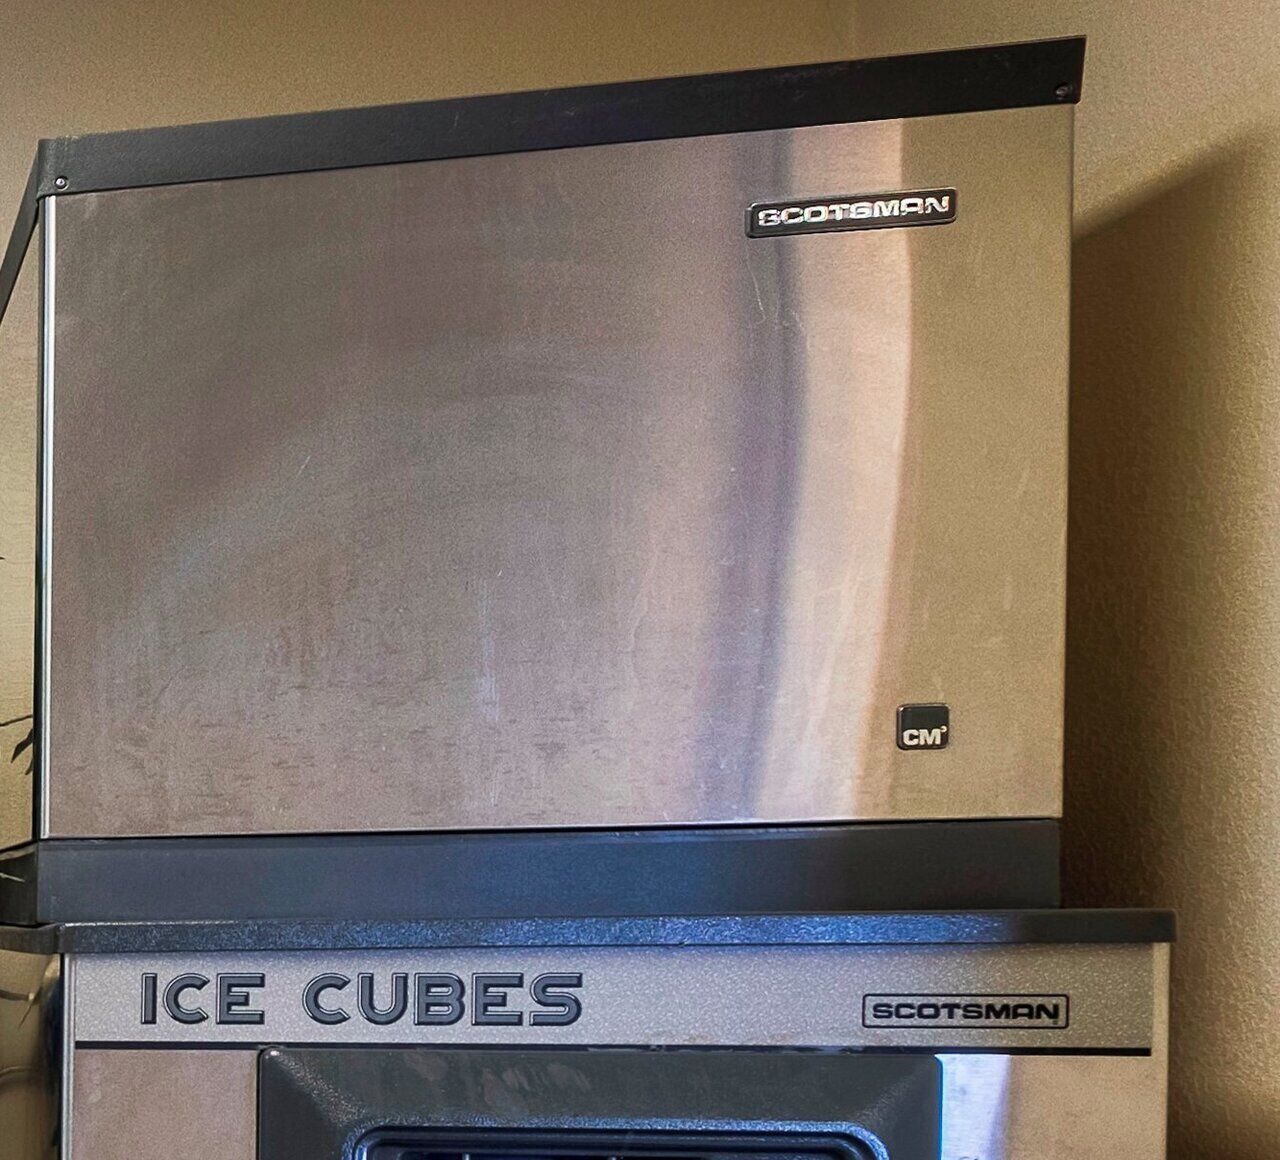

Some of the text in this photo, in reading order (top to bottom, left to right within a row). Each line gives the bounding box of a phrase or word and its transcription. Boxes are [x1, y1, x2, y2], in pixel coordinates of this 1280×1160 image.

[758, 196, 949, 226] SCOTSMAN
[140, 972, 584, 1026] ICE CUBES
[872, 1002, 1060, 1020] SCOTSMAN
